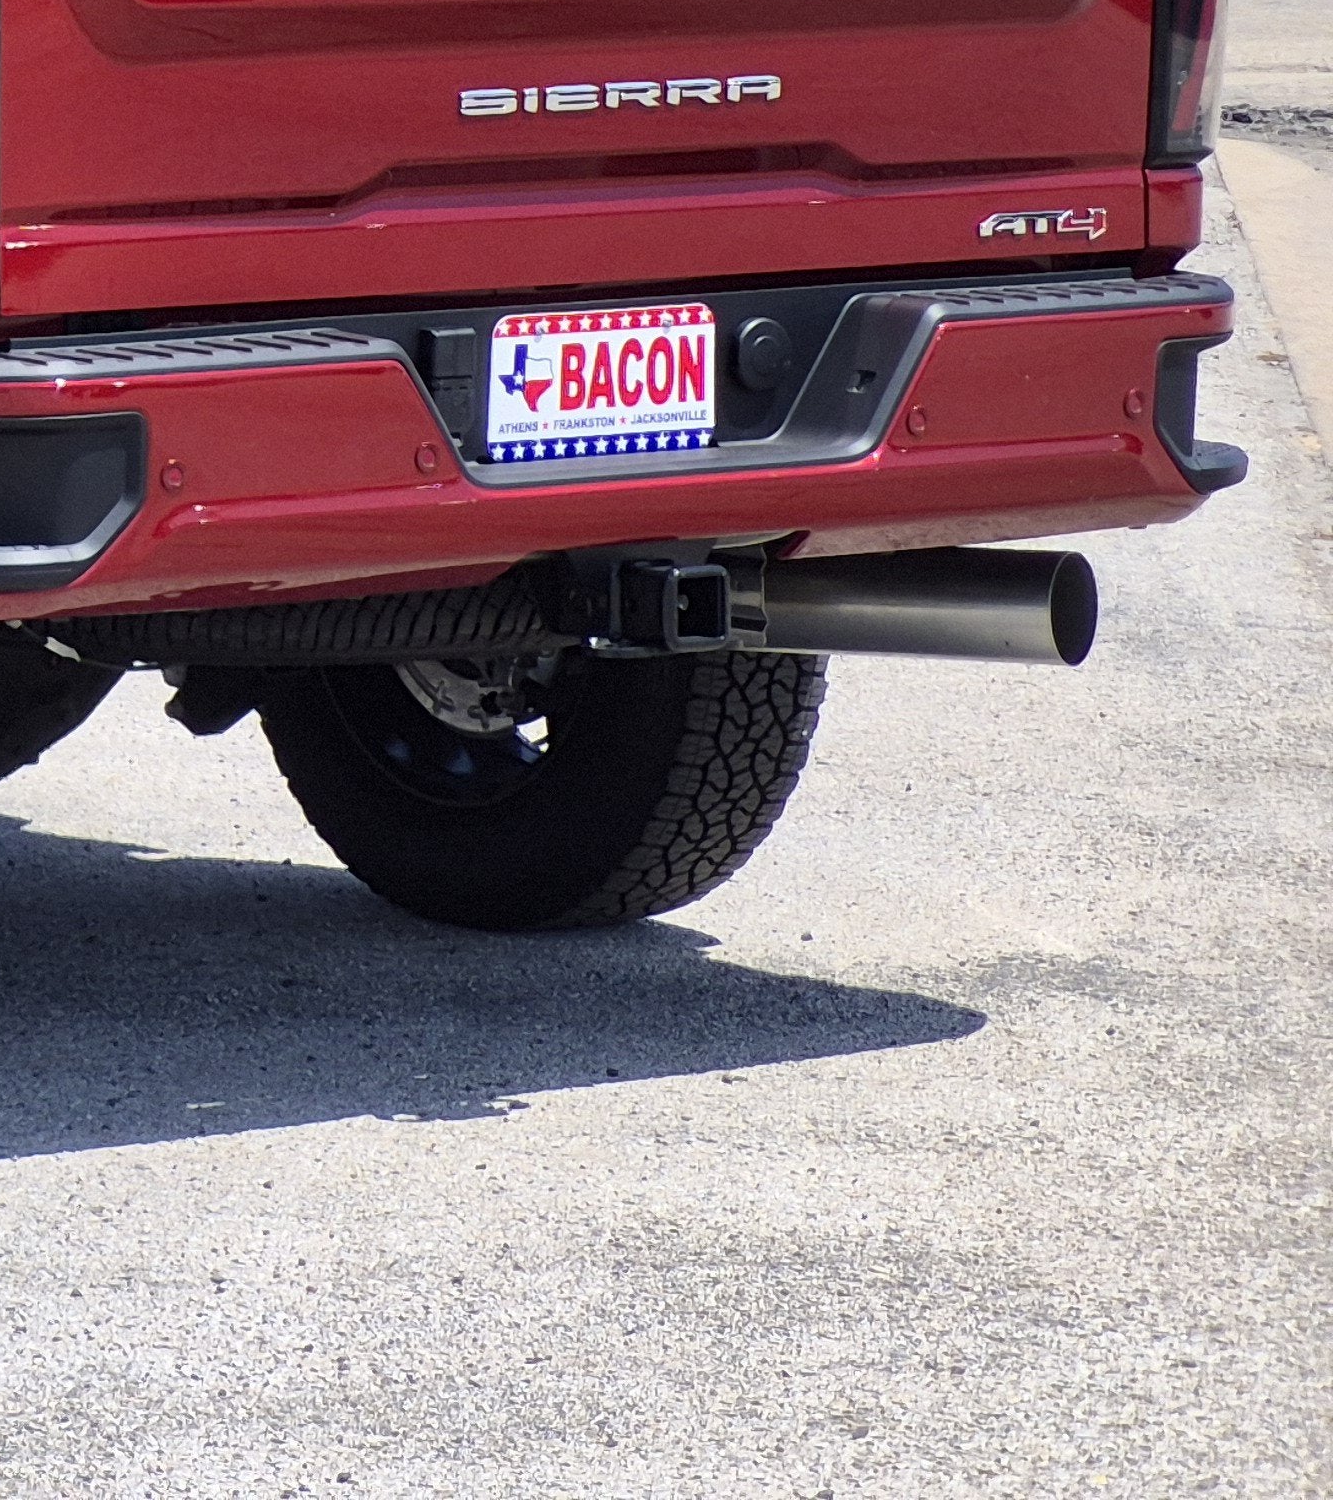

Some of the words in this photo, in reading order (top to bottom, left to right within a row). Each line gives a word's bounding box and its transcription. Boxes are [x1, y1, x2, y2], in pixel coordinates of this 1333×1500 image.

[459, 74, 781, 116] SIERRA
[979, 207, 1107, 241] AT4
[559, 334, 706, 412] BACON
[498, 421, 538, 434] ATHENS
[553, 416, 616, 431] FRANKSTON
[630, 409, 707, 425] JACKSONVILLE
